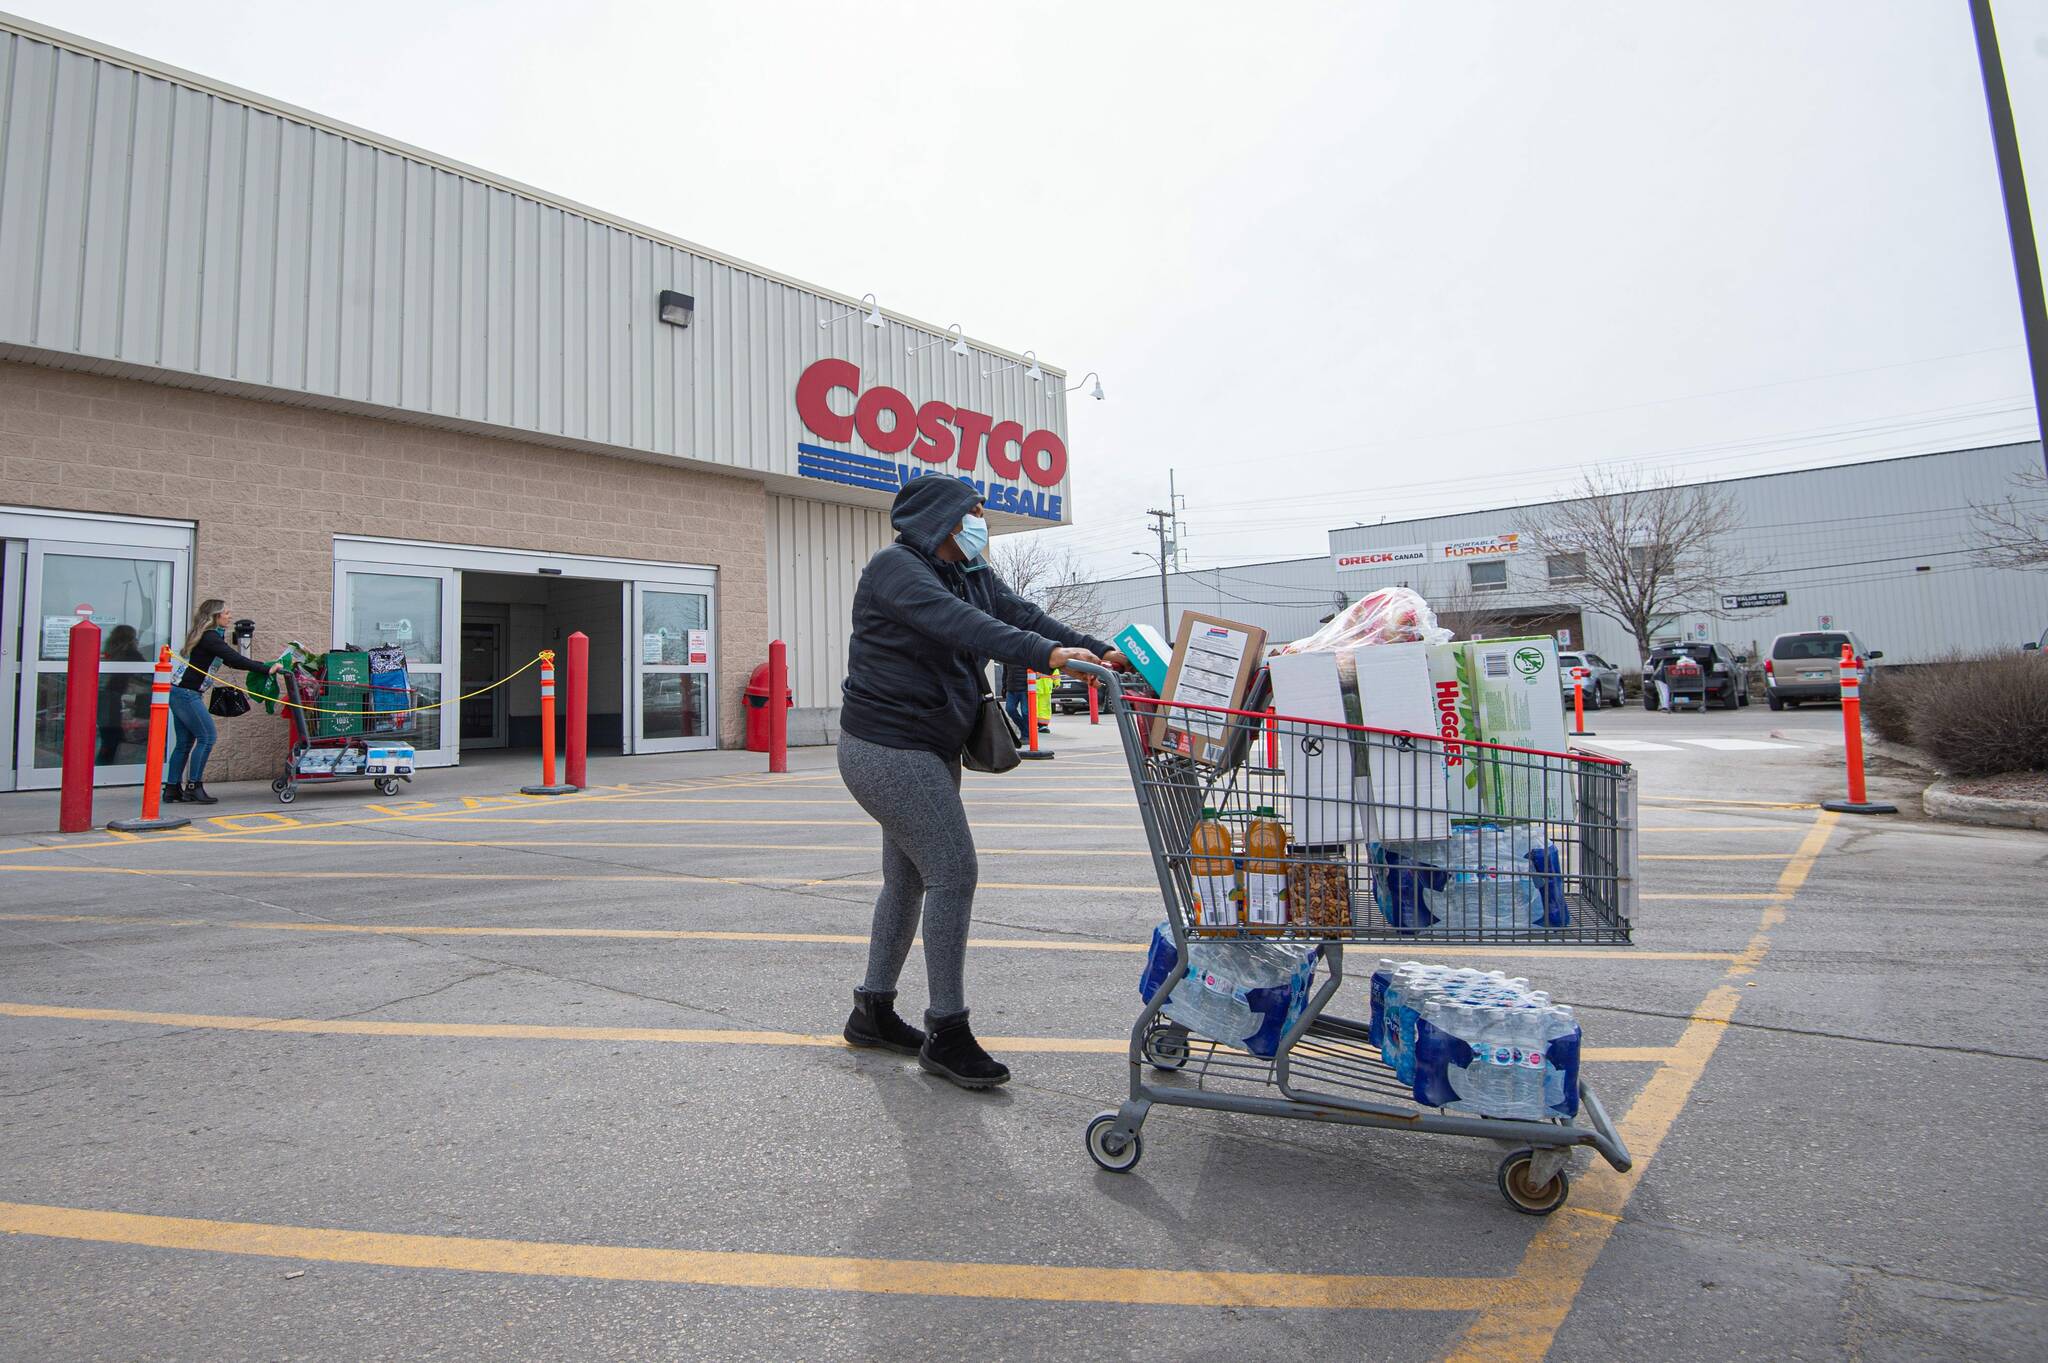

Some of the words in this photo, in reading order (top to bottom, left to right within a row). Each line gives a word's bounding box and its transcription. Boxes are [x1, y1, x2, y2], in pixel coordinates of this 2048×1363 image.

[796, 358, 1067, 487] COSTCO
[1445, 542, 1519, 558] FURNACE
[1453, 540, 1497, 549] PORTABLE
[1338, 552, 1393, 567] ORECK
[1394, 552, 1424, 561] CANADA
